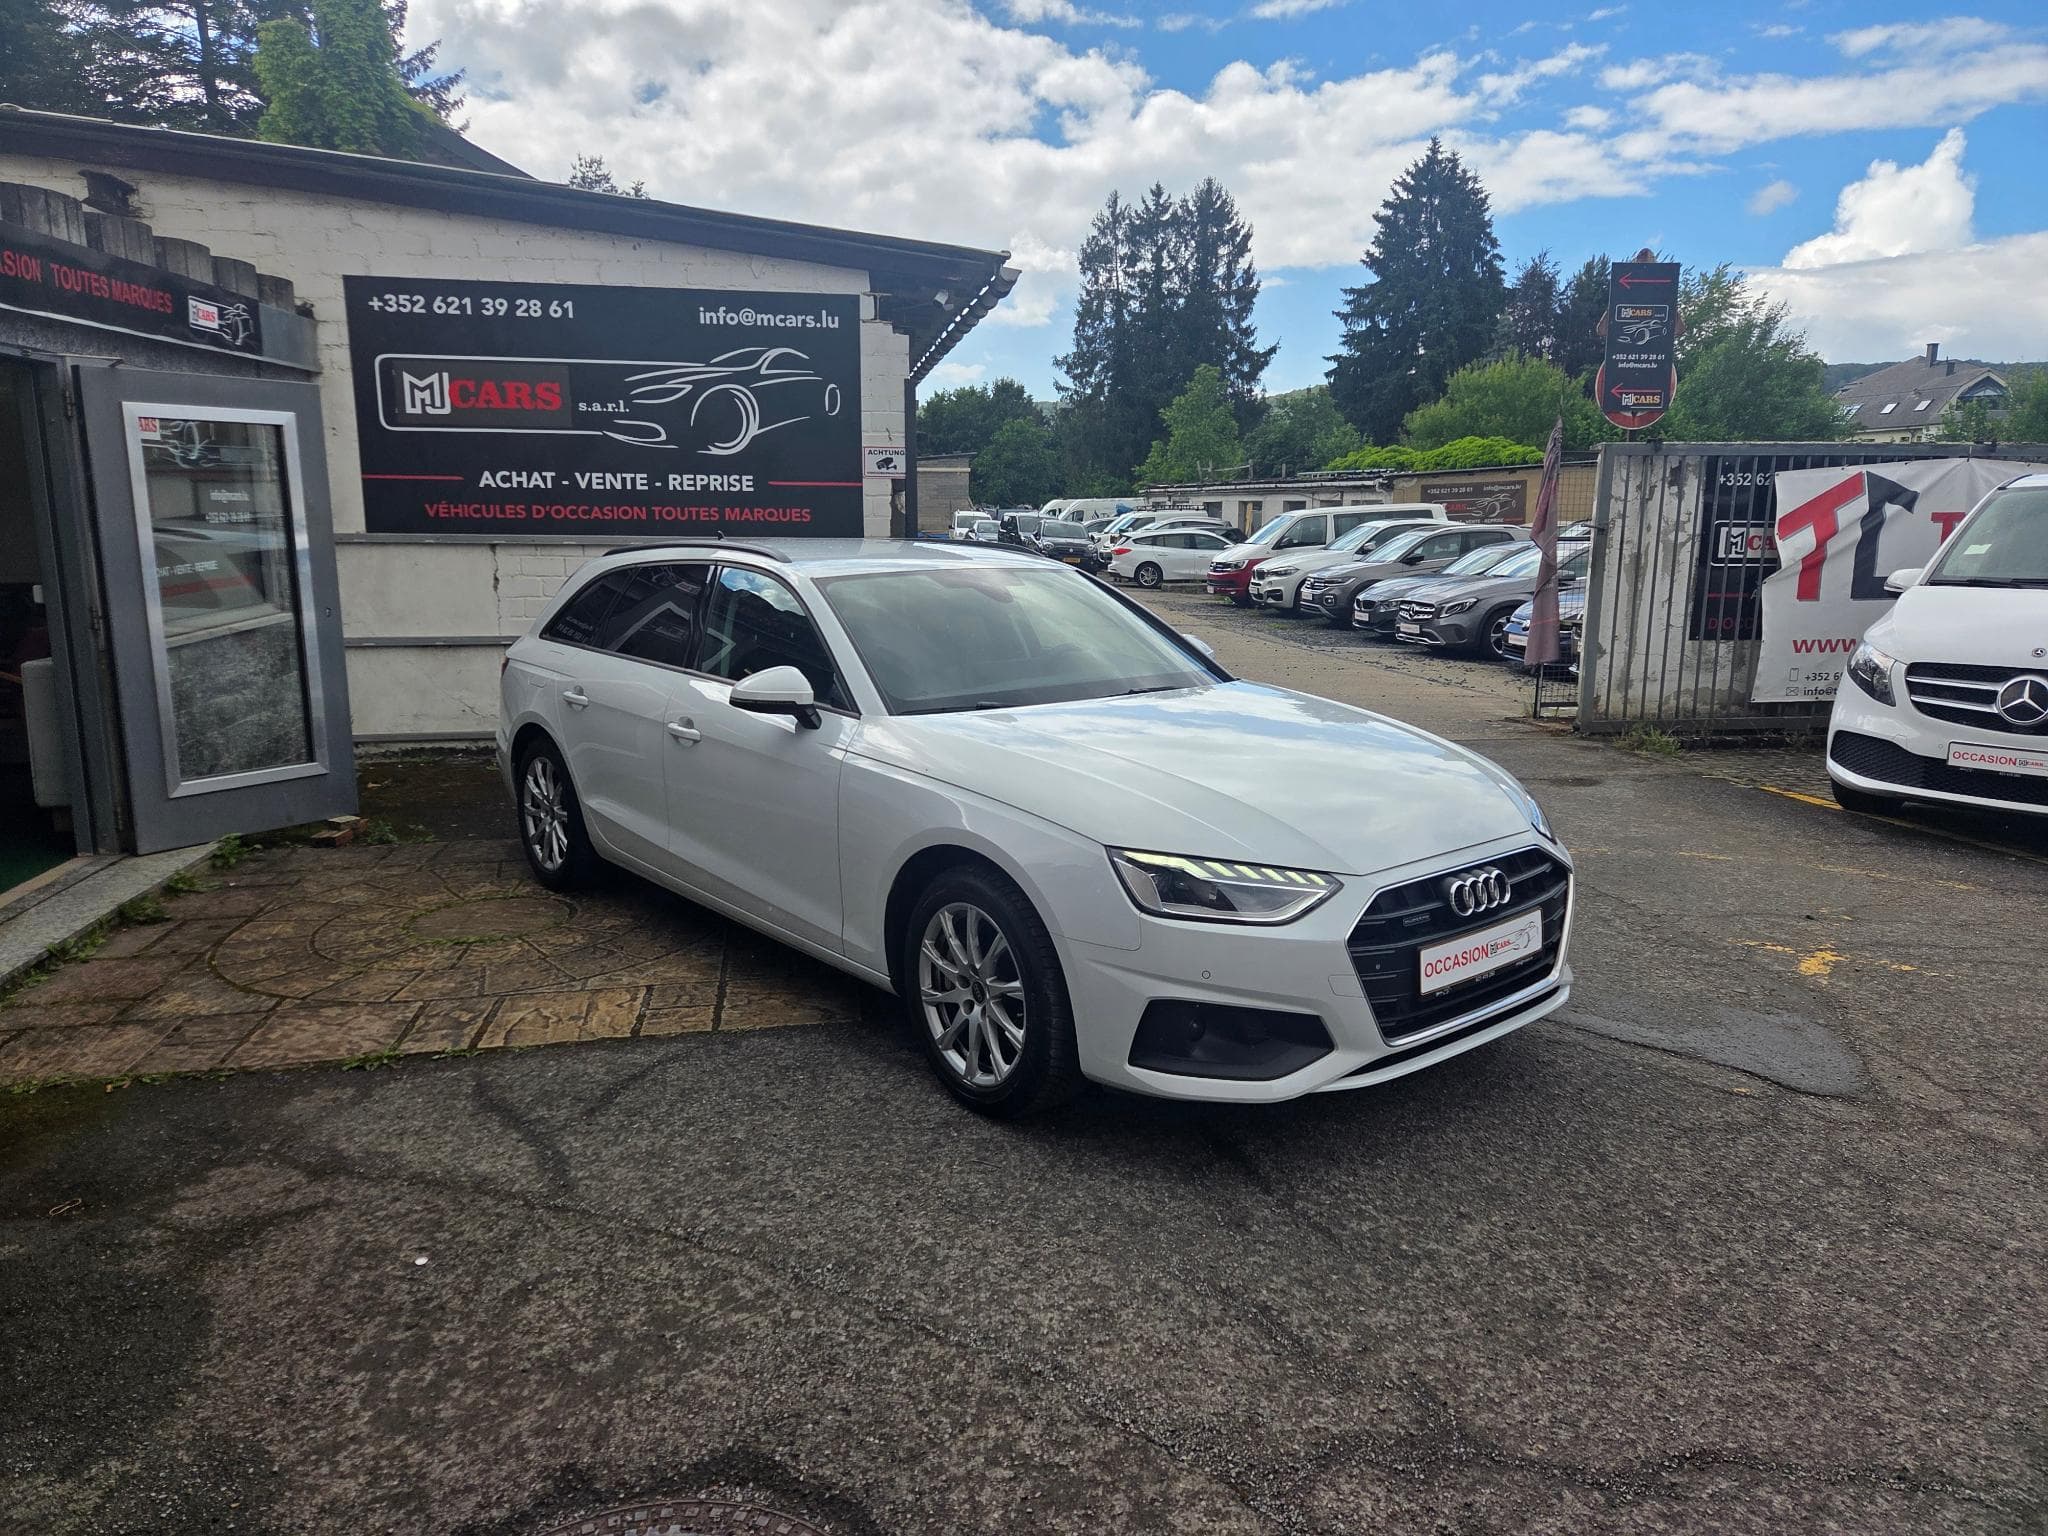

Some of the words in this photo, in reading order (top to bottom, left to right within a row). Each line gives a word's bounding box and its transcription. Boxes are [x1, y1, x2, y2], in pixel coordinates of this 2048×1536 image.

[0, 250, 42, 282] SION
[50, 262, 109, 298] TOUTES
[112, 279, 173, 314] MARQUES
[368, 294, 427, 314] +352
[432, 296, 472, 315] 621
[480, 297, 508, 316] 39
[515, 299, 542, 318] 28
[549, 300, 574, 319] 61
[698, 306, 839, 329] info@mcars.lu
[578, 400, 630, 413] s.a.r.l.
[478, 470, 556, 489] ACHAT
[575, 472, 649, 491] VENTE
[668, 474, 754, 492] REPRISE
[424, 501, 526, 519] VÉHICULES
[532, 505, 647, 520] D'OCCASION
[652, 506, 720, 521] TOUTES
[724, 507, 811, 522] MARQUES
[1804, 672, 1830, 681] +352
[1952, 751, 2017, 767] OCCASION
[1424, 943, 1489, 978] OCCASION
